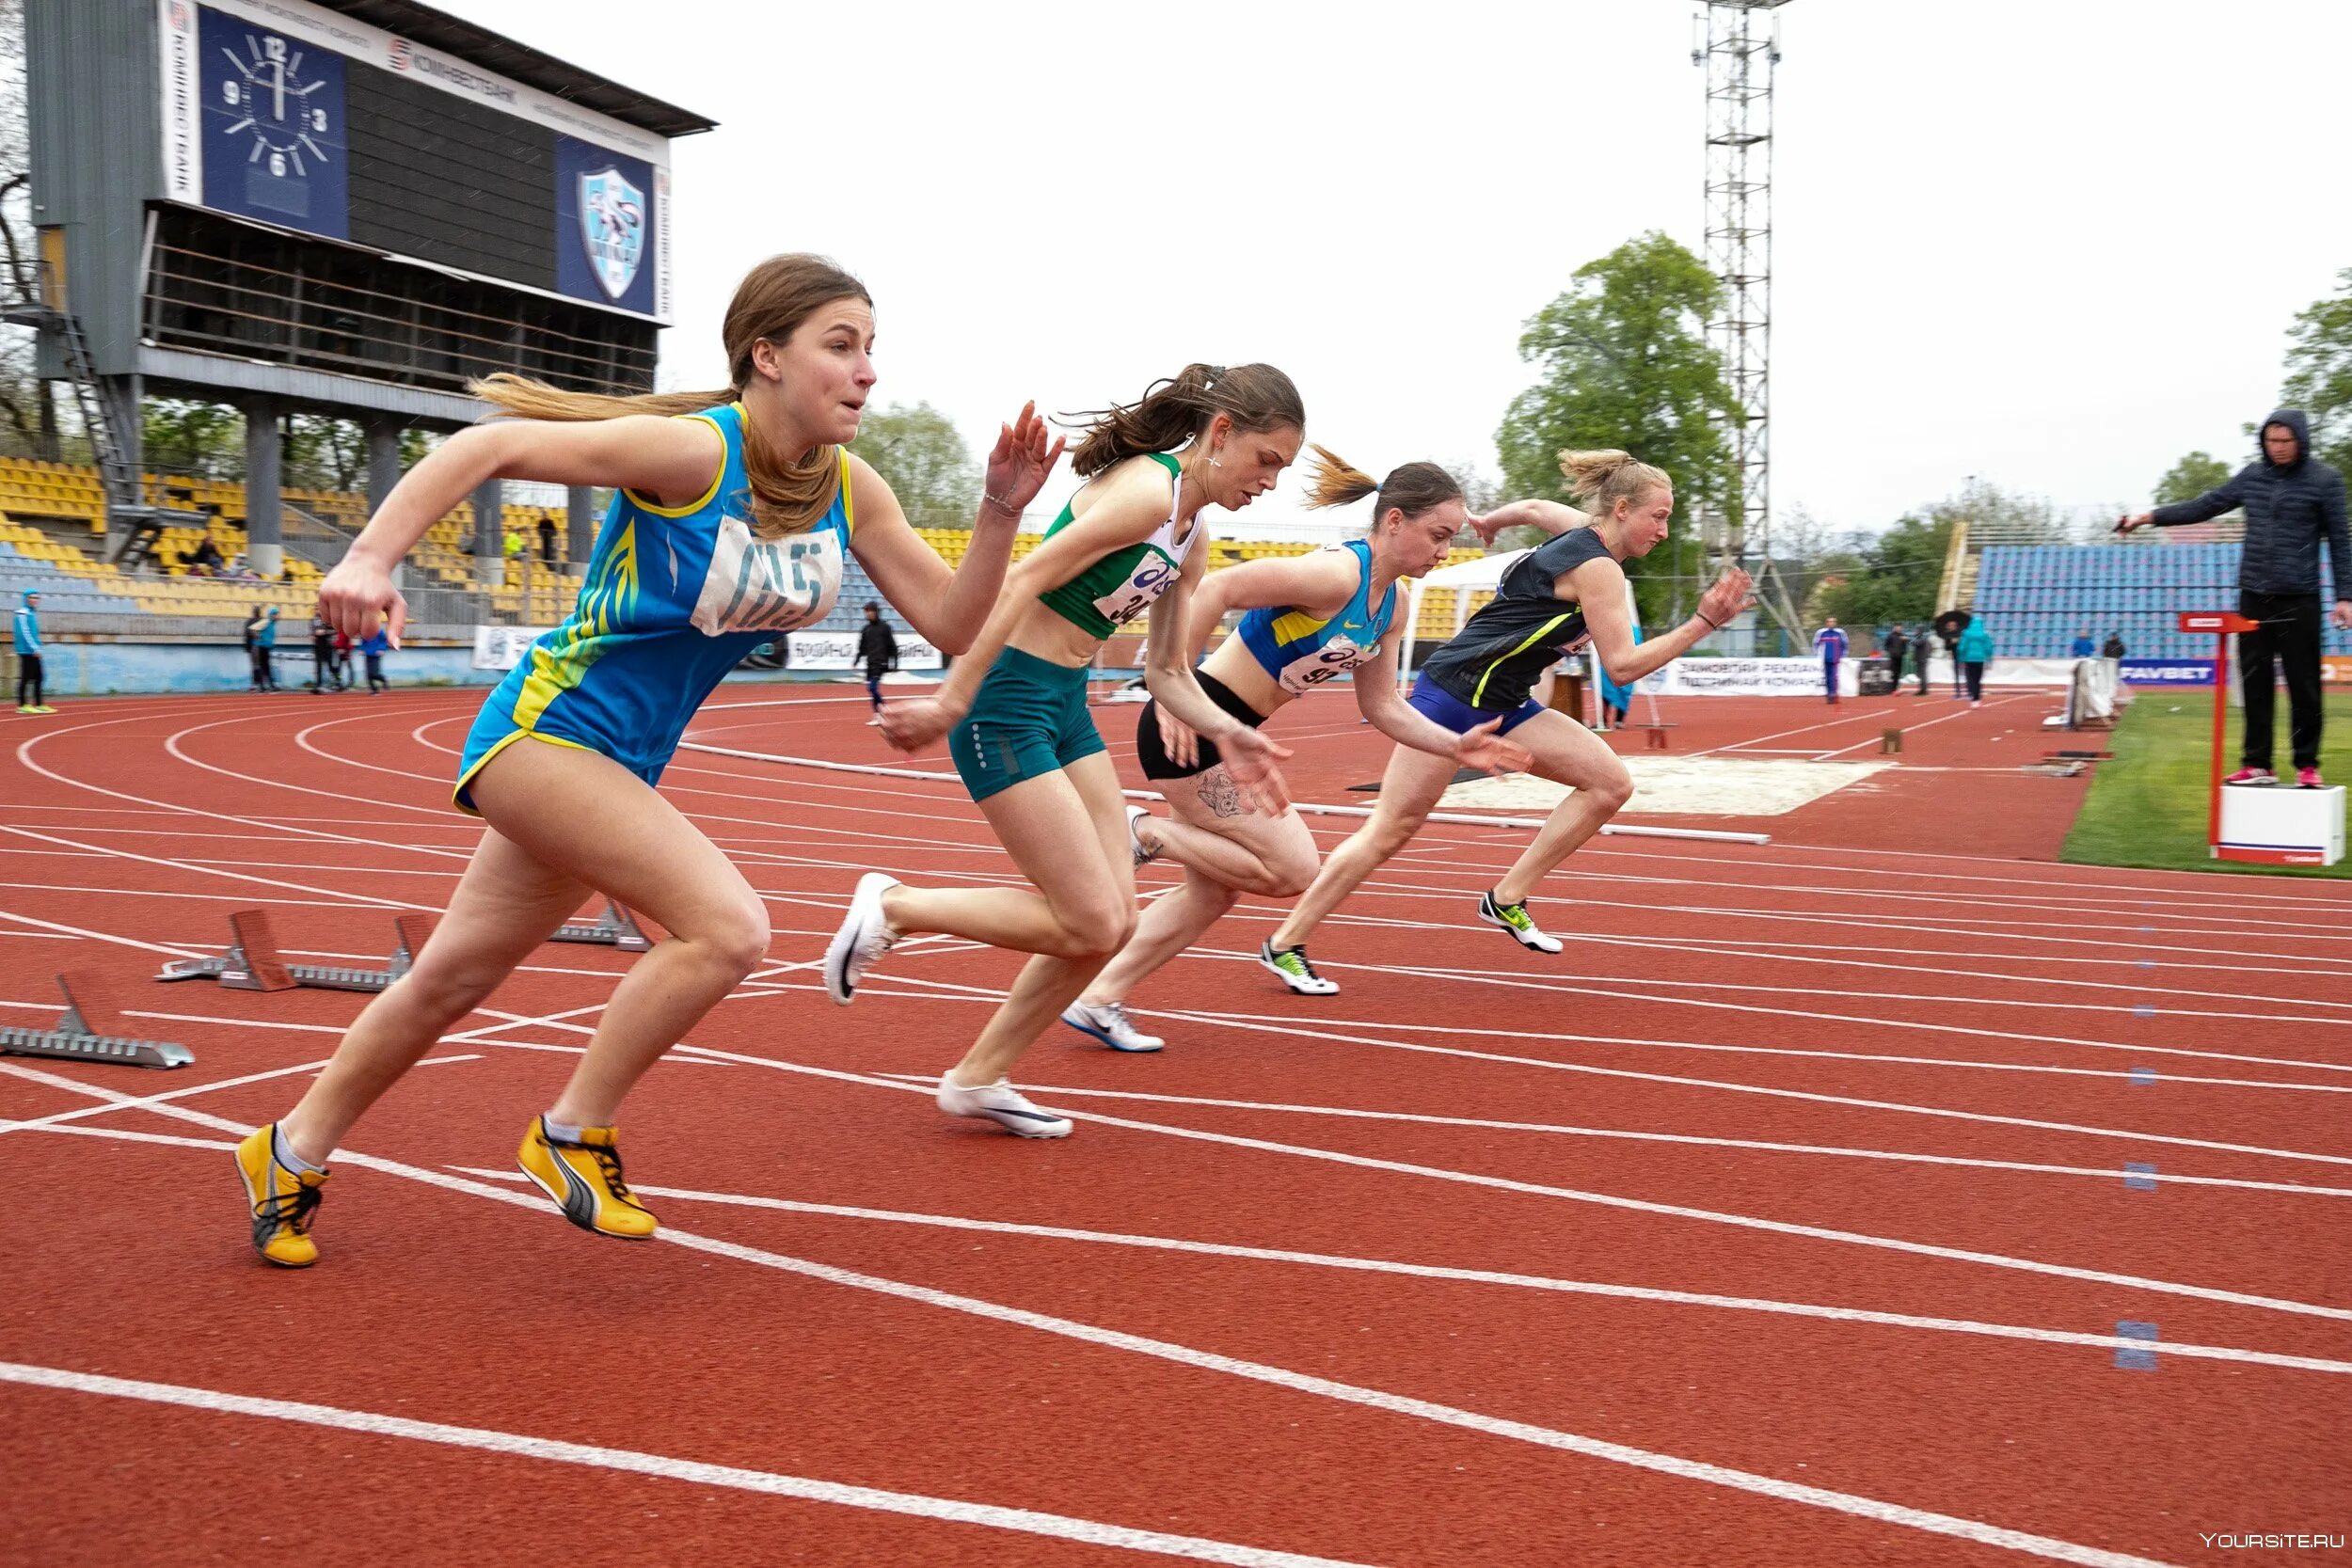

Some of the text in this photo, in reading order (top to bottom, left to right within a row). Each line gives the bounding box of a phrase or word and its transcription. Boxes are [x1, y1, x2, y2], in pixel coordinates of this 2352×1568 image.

[223, 80, 241, 105] 9
[311, 108, 327, 133] 3
[269, 152, 287, 177] 6
[2120, 666, 2213, 680] FAVBET
